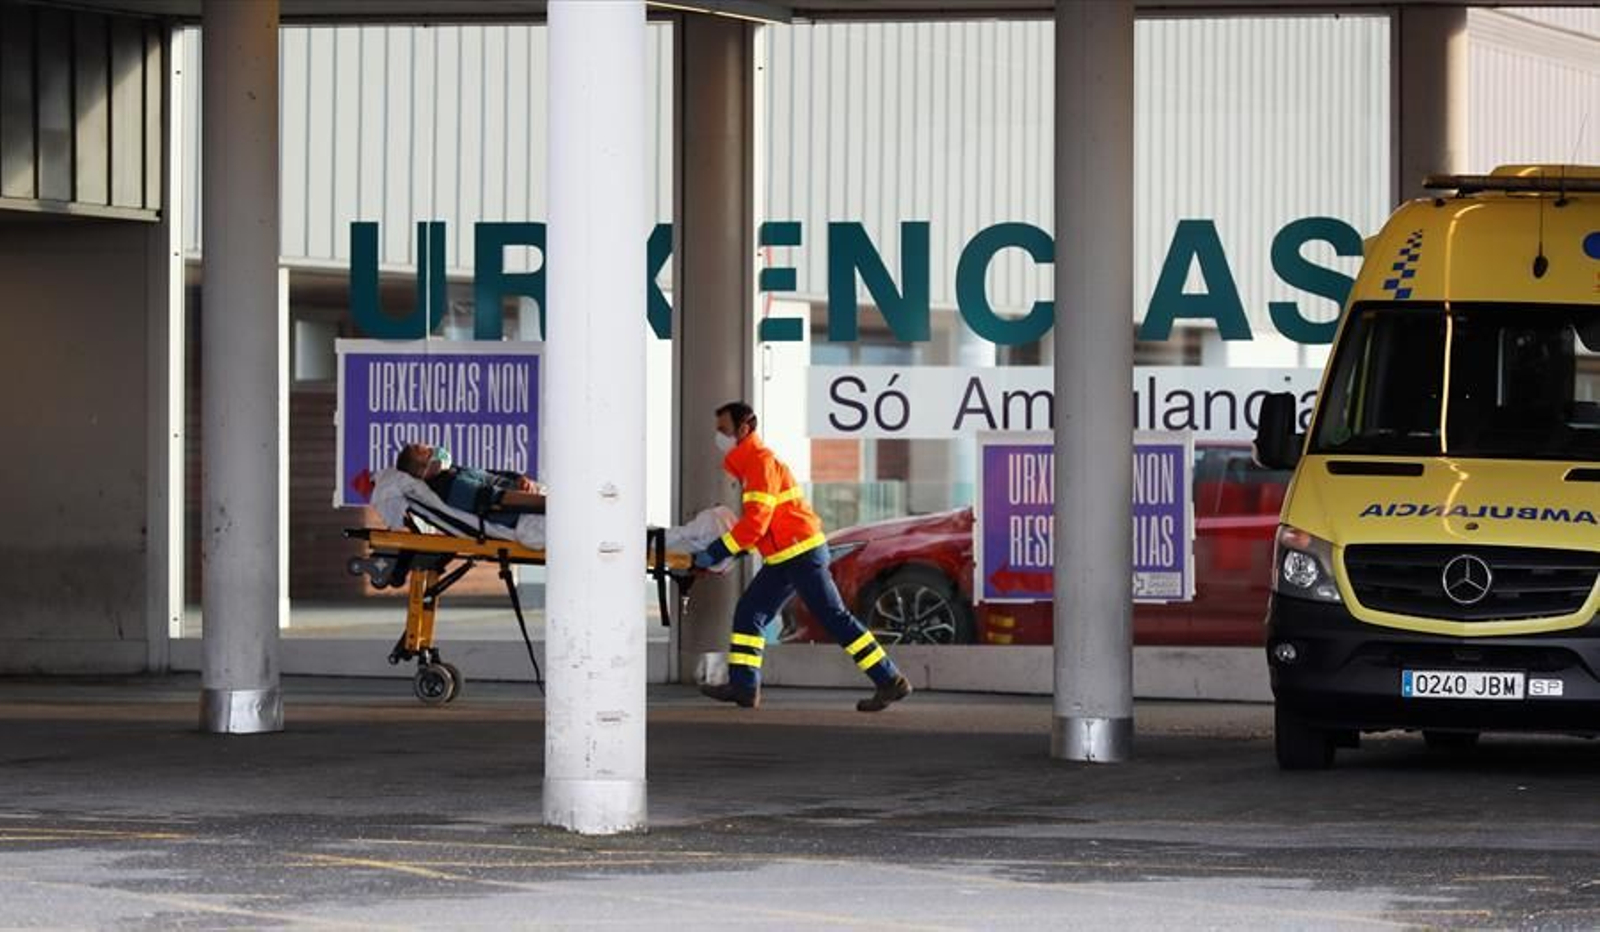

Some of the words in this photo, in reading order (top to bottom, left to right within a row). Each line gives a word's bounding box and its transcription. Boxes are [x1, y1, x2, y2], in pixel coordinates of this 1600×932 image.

[350, 217, 1364, 344] URENCAS
[369, 362, 480, 413] URXENCIAS
[488, 363, 529, 413] NON
[829, 373, 910, 432] Só
[953, 375, 1318, 431] Amlanc
[1132, 453, 1174, 504] NON
[1416, 675, 1467, 695] 0240
[1475, 676, 1516, 696] JBM
[1532, 681, 1561, 694] SP
